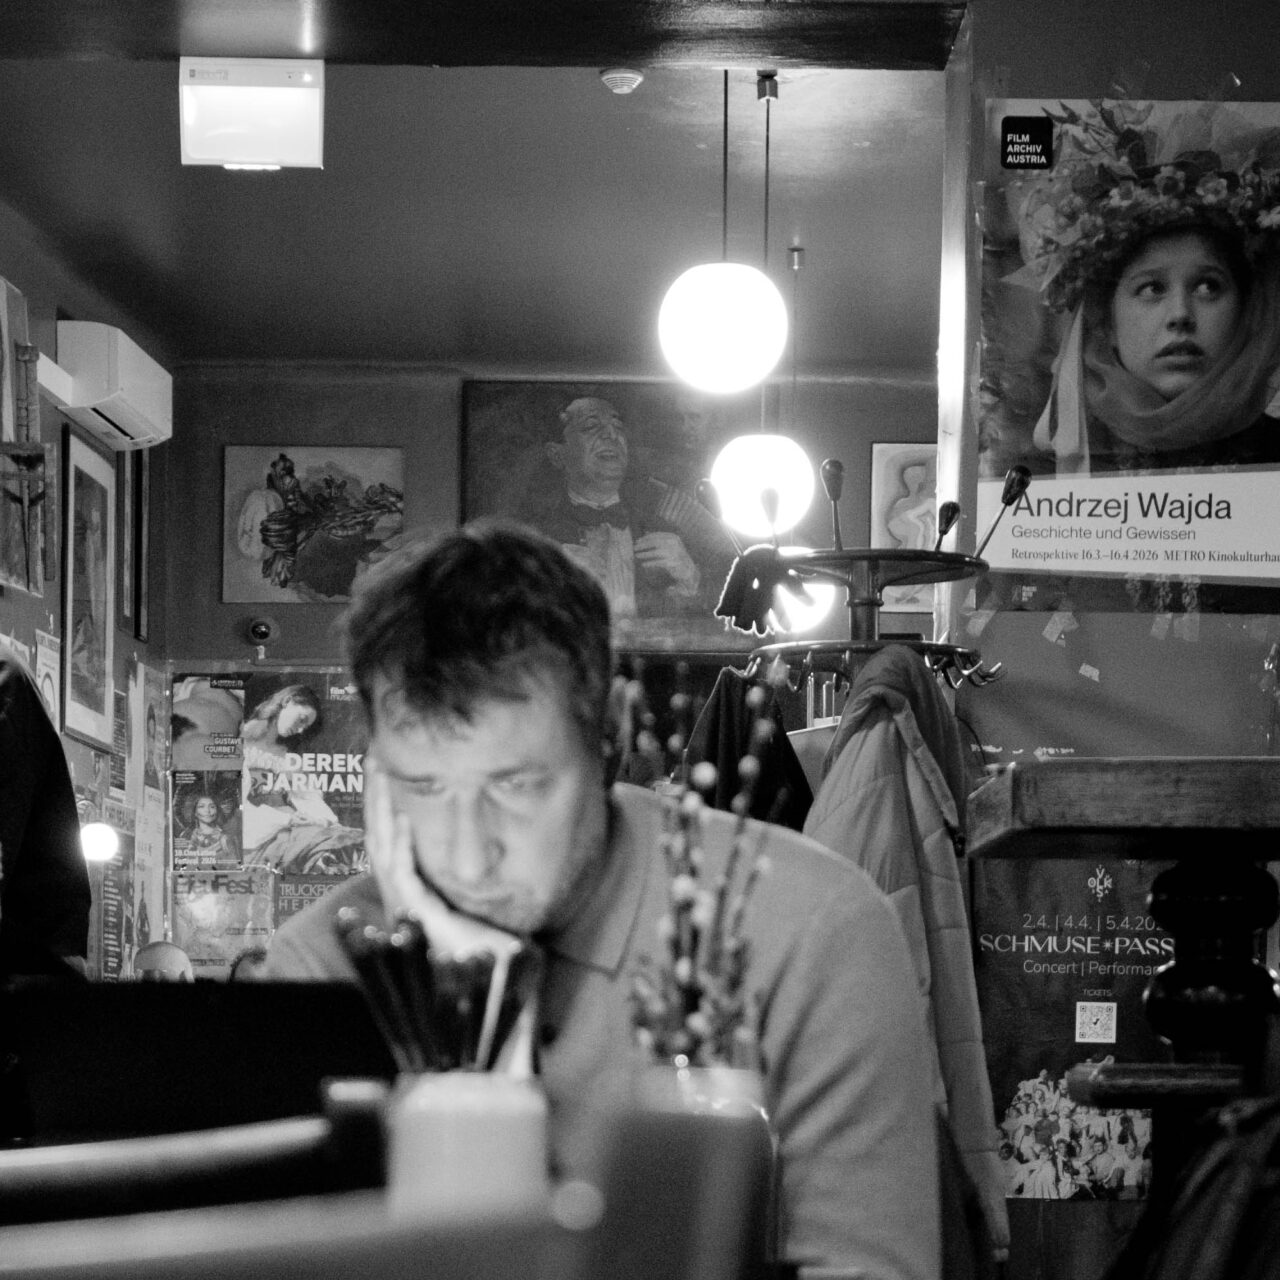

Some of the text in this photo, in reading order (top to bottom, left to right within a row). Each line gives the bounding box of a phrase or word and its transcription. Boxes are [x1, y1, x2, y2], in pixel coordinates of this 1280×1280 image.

[1007, 133, 1030, 143] FILM
[1006, 144, 1042, 153] ARCHIV
[1006, 154, 1047, 164] AUSTRIA
[1012, 490, 1232, 525] Andrzej Wajda
[1011, 524, 1196, 540] Geschichte und Gewissen
[1011, 548, 1079, 562] Retrospektive
[1163, 550, 1206, 561] METRO
[204, 745, 236, 753] COURBET
[285, 752, 364, 773] DEREK
[262, 773, 364, 793] JARMAN
[1022, 913, 1051, 929] 2.4.
[1064, 914, 1093, 930] 4.4.
[1106, 915, 1164, 931] 5.4.20
[1114, 936, 1176, 956] PASS
[1023, 959, 1078, 974] Concert
[1083, 989, 1112, 997] TICKETS
